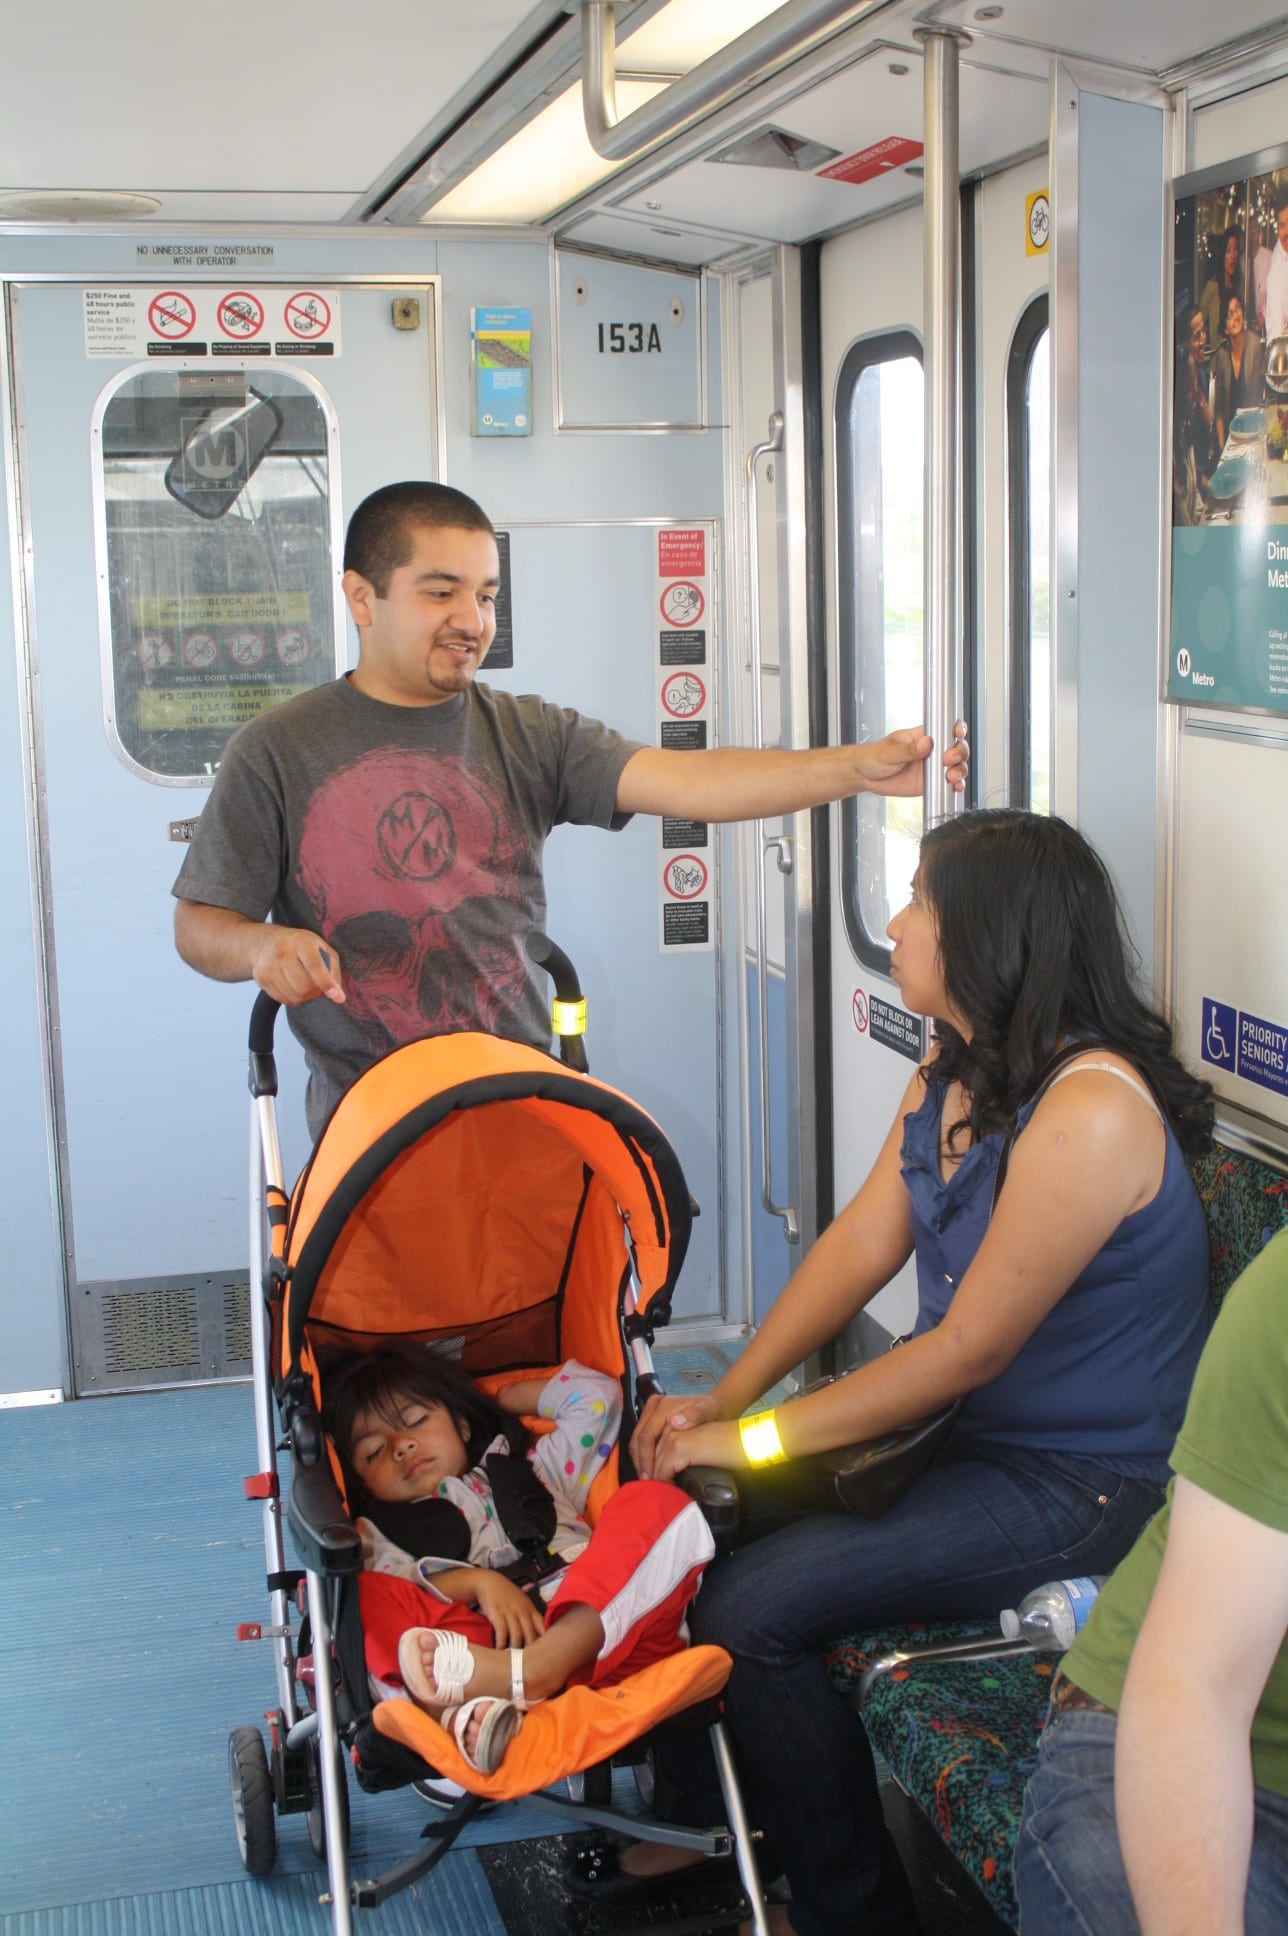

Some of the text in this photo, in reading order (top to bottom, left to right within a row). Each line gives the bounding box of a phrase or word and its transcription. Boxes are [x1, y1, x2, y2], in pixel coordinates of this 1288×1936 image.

[137, 246, 274, 255] NO UNNECESSARY CONVERSATION
[173, 256, 237, 265] WITH OPERATOR
[598, 322, 662, 353] 153A
[661, 532, 668, 540] In
[669, 532, 689, 540] Event
[208, 597, 242, 606] BLOCK
[1192, 672, 1215, 687] Metro
[253, 688, 292, 698] PUERTA
[223, 702, 262, 711] CABINA
[870, 999, 913, 1030] DO NOT BLOCK OR
[870, 1012, 884, 1028] LEAN
[884, 1019, 905, 1039] AGAINST
[905, 1030, 920, 1048] DOOR
[1242, 1020, 1287, 1052] PRIORITY
[1241, 1040, 1284, 1070] SENIORS
